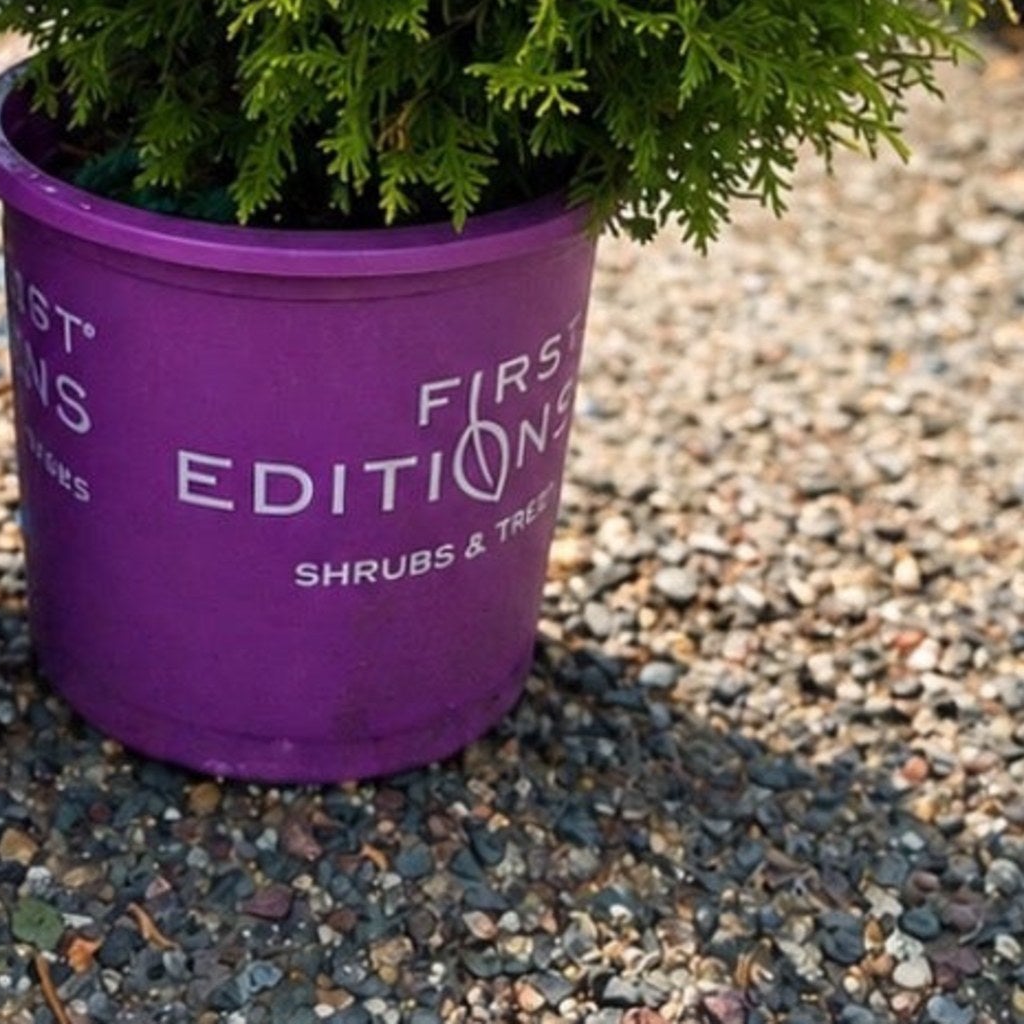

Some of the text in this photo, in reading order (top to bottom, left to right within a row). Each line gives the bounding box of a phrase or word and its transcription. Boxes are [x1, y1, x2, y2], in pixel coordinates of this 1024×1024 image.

[177, 378, 574, 516] EDITIONS
[294, 543, 456, 588] SHRUBS
[463, 531, 487, 560] &
